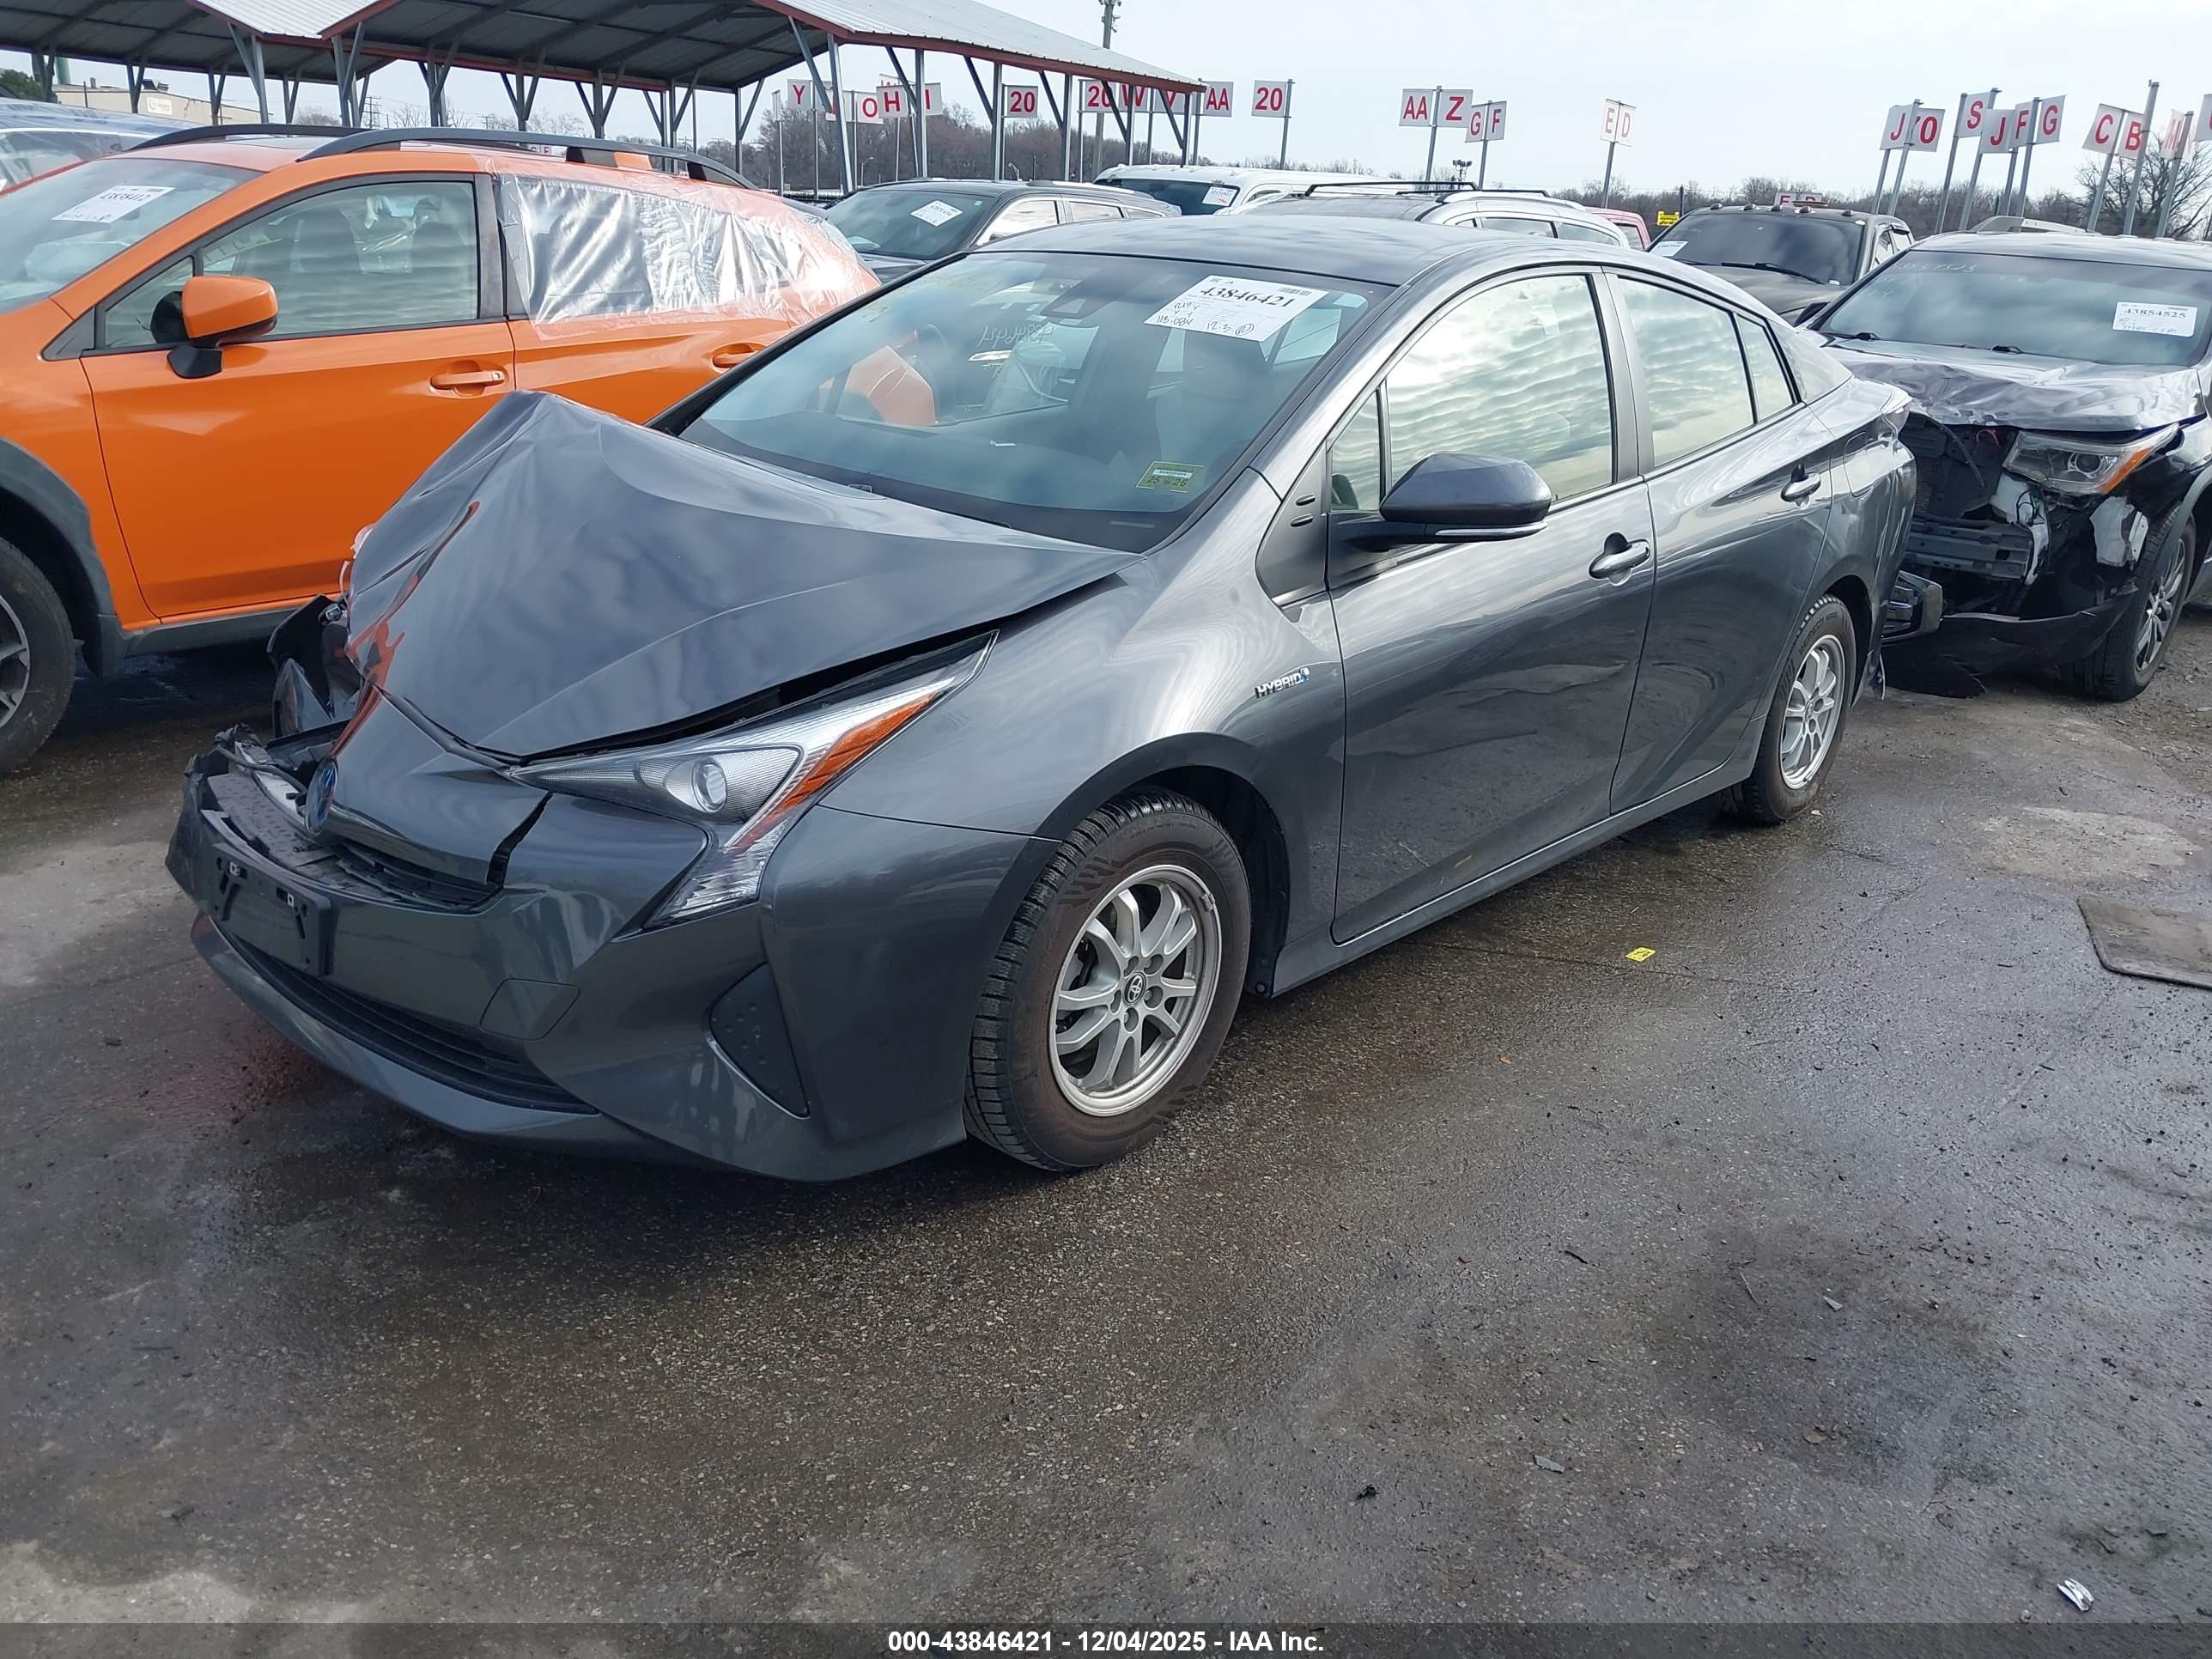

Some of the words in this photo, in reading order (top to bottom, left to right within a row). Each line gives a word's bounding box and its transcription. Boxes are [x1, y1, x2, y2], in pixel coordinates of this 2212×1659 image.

[793, 84, 805, 105] Y
[884, 90, 901, 112] H
[1009, 90, 1036, 112] 20
[1206, 87, 1230, 111] AA
[1255, 87, 1283, 112] 20
[1402, 95, 1428, 120] AA
[1445, 96, 1465, 121] Z
[1966, 100, 1984, 130] S
[1470, 111, 1481, 136] G
[1492, 108, 1502, 133] F
[1605, 107, 1615, 134] E
[1621, 112, 1631, 138] D
[1890, 112, 1906, 141] J
[1990, 116, 2007, 146] J
[2014, 109, 2030, 139] F
[2043, 105, 2058, 136] G
[2094, 113, 2114, 144] C
[2124, 120, 2142, 151] B
[1200, 286, 1296, 307] 43846421
[1172, 478, 1188, 487] 26
[1254, 672, 1303, 699] HYBRID
